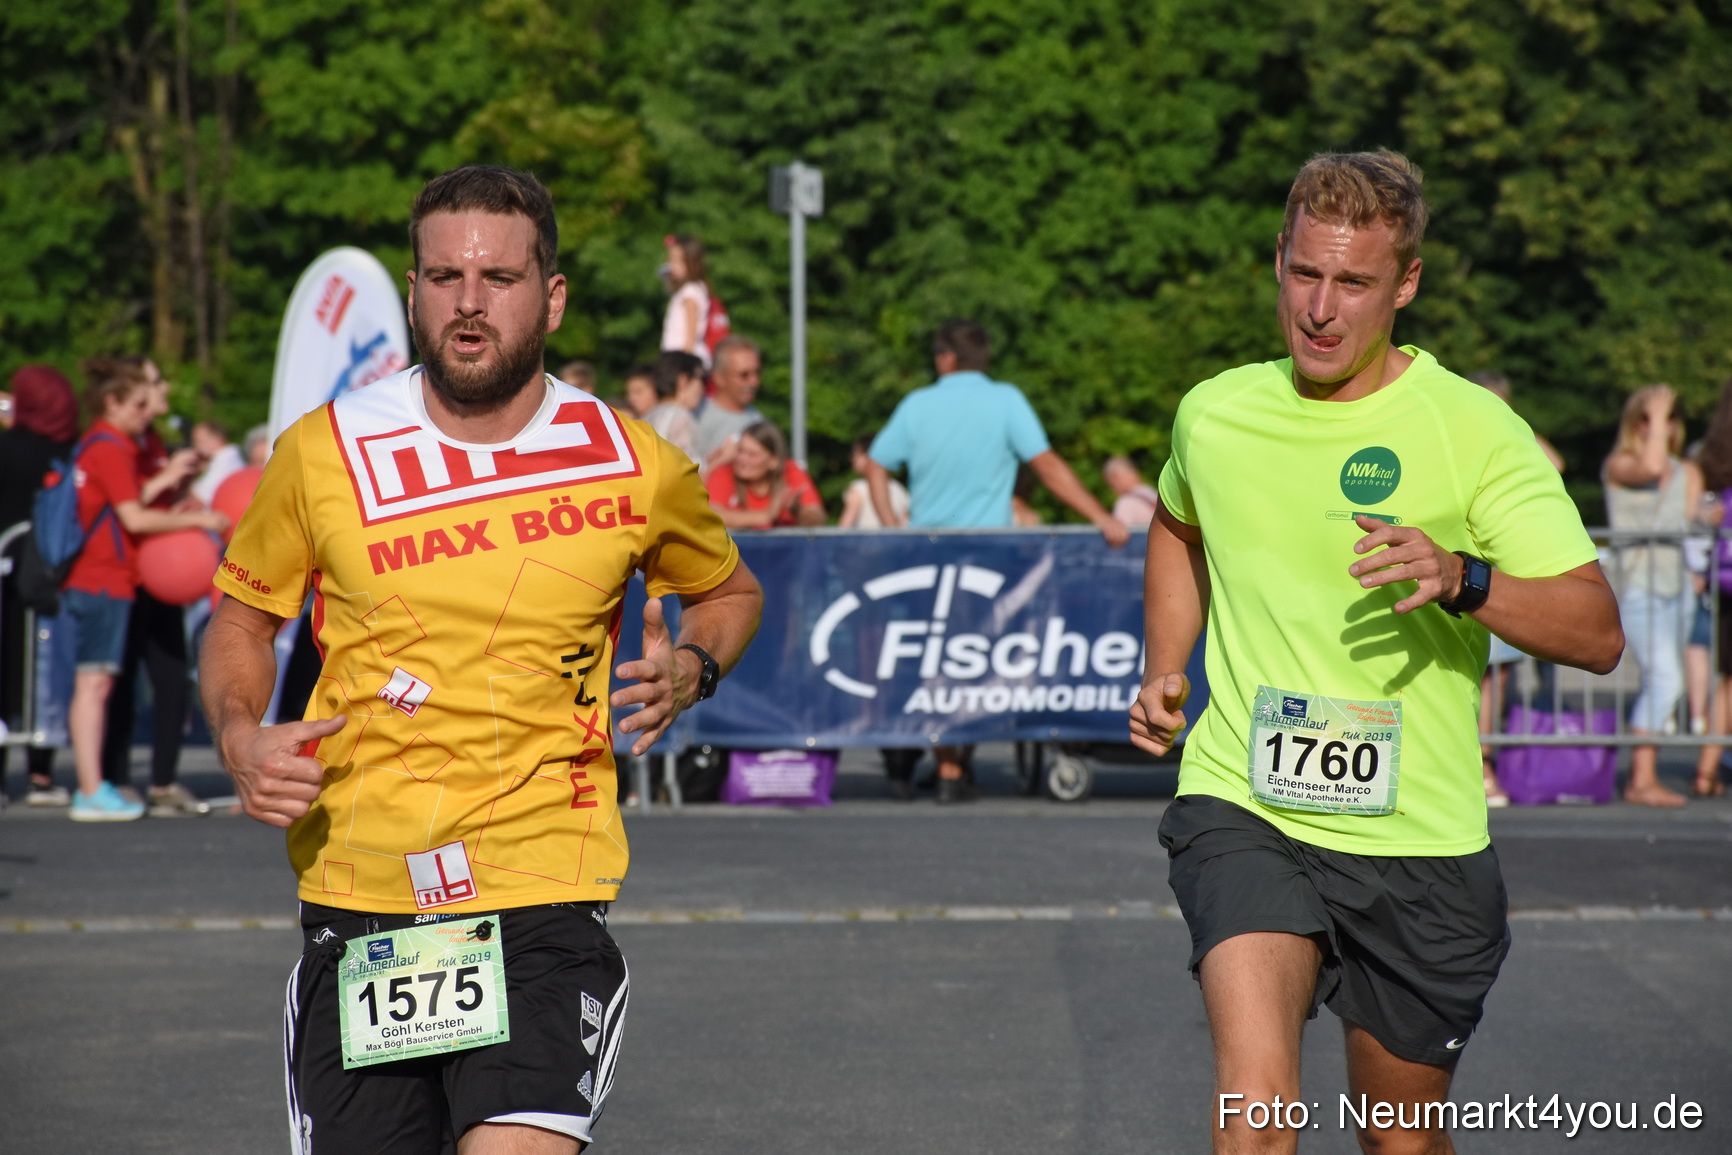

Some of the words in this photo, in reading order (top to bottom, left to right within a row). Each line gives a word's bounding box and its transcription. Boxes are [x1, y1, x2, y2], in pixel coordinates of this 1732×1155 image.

[1344, 479, 1393, 487] apotheke
[367, 518, 498, 575] MAX
[511, 495, 647, 544] BÖGL
[876, 616, 1146, 679] Fische
[1271, 711, 1329, 730] firmenlauf
[1364, 732, 1392, 741] 2019
[1266, 732, 1379, 782] 1760
[1267, 774, 1331, 792] Eichenseer
[1334, 783, 1371, 795] Marco
[1272, 787, 1285, 796] NM
[1305, 792, 1344, 803] Apotheke
[1346, 796, 1362, 804] e.K.
[358, 951, 420, 974] firmenlauf
[461, 951, 491, 965] 2019
[359, 966, 483, 1027] 1575
[582, 994, 602, 1018] TSV
[366, 1043, 382, 1052] Max
[384, 1039, 404, 1050] Bögl
[406, 1032, 454, 1045] Bauservice
[456, 1026, 483, 1037] GmbH
[381, 1024, 411, 1038] Göhl
[415, 1018, 465, 1033] Kersten
